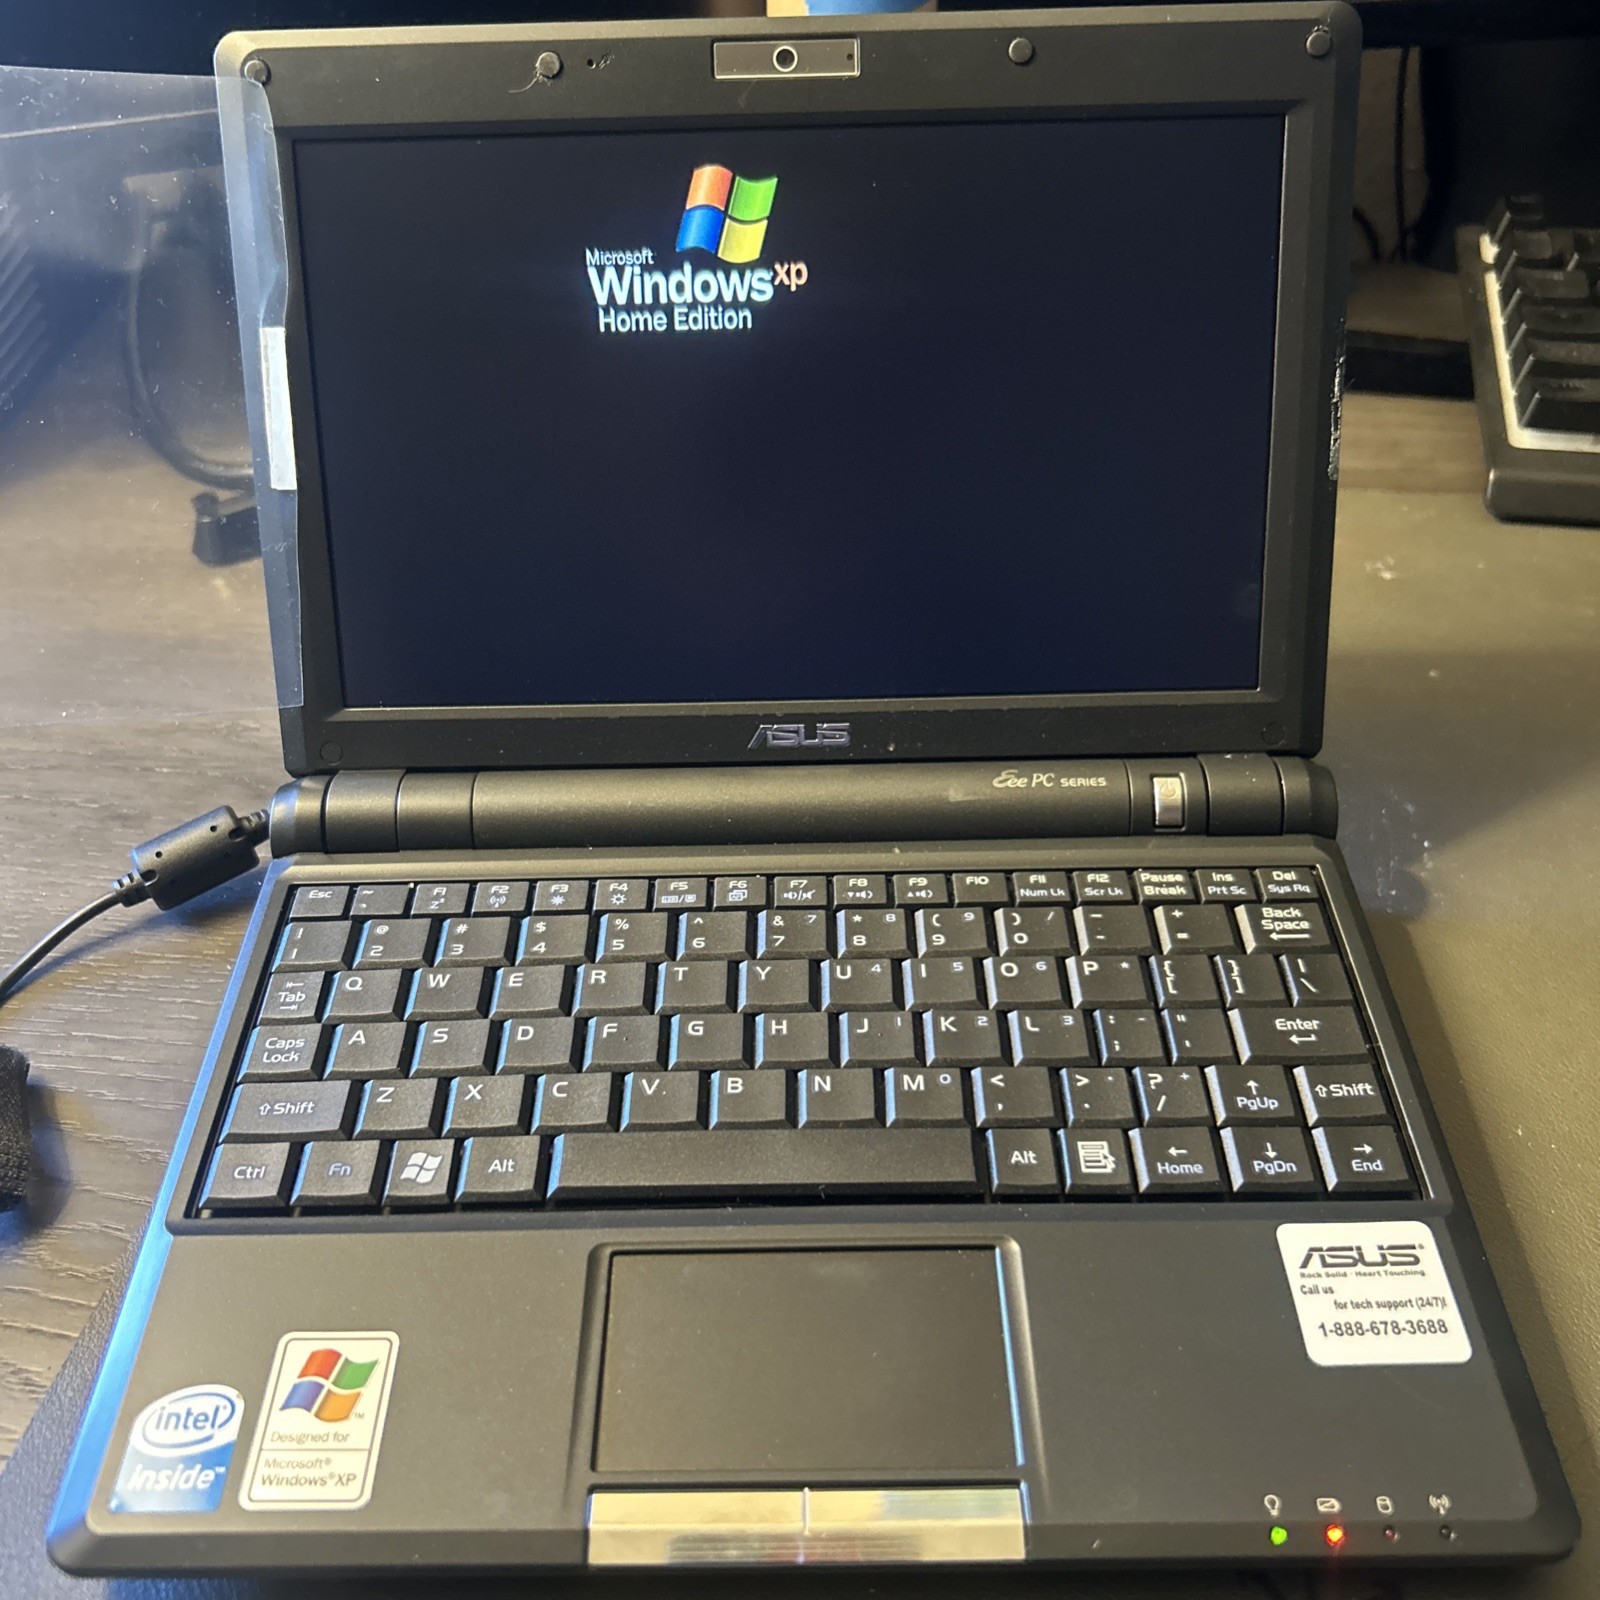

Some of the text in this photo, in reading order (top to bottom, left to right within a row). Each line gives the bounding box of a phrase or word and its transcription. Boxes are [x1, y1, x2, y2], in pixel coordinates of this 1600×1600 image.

[585, 247, 654, 266] Microsoft
[587, 261, 809, 306] Windows xp
[598, 304, 753, 333] Home Edition
[747, 722, 851, 750] ASUS
[992, 769, 1107, 788] Eee PC SERIES
[848, 878, 868, 887] F8
[908, 877, 928, 887] F9
[1140, 872, 1184, 883] Pause
[1211, 872, 1234, 882] Ins
[1272, 870, 1297, 881] Del
[490, 885, 510, 894] F2
[550, 883, 569, 893] F3
[609, 882, 629, 892] F4
[669, 881, 689, 891] F5
[728, 880, 748, 889] F6
[789, 879, 808, 889] F7
[1143, 885, 1187, 896] Break
[1207, 885, 1247, 895] Prt Sc
[1267, 883, 1311, 894] Sys Rq
[308, 889, 333, 899] Esc
[1019, 888, 1066, 897] Num Lk
[1084, 887, 1123, 896] Scr Lk
[807, 914, 817, 924] 7
[885, 913, 896, 922] 8
[963, 912, 975, 921] 9
[1011, 912, 1021, 926] )
[1047, 911, 1054, 921] /
[1261, 907, 1302, 918] Back
[535, 921, 547, 933] $
[614, 918, 630, 930] %
[772, 915, 785, 927] &
[932, 913, 941, 927] (
[1260, 919, 1310, 932] Space
[375, 925, 390, 935] @
[456, 923, 469, 934] #
[612, 939, 625, 951] 5
[692, 937, 706, 949] 6
[772, 935, 785, 947] 7
[852, 934, 867, 946] 8
[932, 933, 946, 946] 9
[369, 945, 384, 957] 2
[450, 943, 464, 955] 3
[532, 941, 547, 954] 4
[836, 965, 852, 980] U
[870, 963, 882, 973] 4
[952, 961, 964, 972] 5
[1000, 962, 1019, 977] O
[1035, 961, 1047, 971] 6
[1082, 960, 1099, 976] P
[1163, 960, 1175, 976] {
[1227, 959, 1239, 977] }
[428, 973, 451, 988] W
[508, 972, 524, 987] E
[590, 969, 607, 984] R
[673, 966, 689, 981] T
[755, 966, 772, 981] Y
[344, 976, 363, 991] Q
[1165, 977, 1178, 994] [
[1232, 976, 1244, 994] ]
[1300, 977, 1317, 993] \
[278, 991, 306, 1003] Tab
[771, 1019, 787, 1035] H
[856, 1018, 869, 1034] J
[940, 1016, 957, 1032] K
[977, 1015, 988, 1026] 2
[1024, 1016, 1040, 1032] L
[1062, 1015, 1074, 1026] 3
[1274, 1018, 1320, 1031] Enter
[516, 1025, 534, 1041] D
[602, 1022, 618, 1038] F
[687, 1020, 704, 1036] G
[347, 1029, 366, 1045] A
[432, 1027, 449, 1044] S
[265, 1037, 306, 1051] Caps
[262, 1050, 300, 1063] Lock
[641, 1078, 660, 1095] V
[727, 1077, 743, 1094] B
[814, 1075, 831, 1092] N
[903, 1074, 925, 1091] M
[990, 1074, 1005, 1087] <
[1075, 1074, 1090, 1087] >
[1147, 1073, 1163, 1090] ?
[376, 1086, 395, 1103] Z
[464, 1083, 484, 1101] X
[552, 1081, 569, 1098] C
[1329, 1082, 1375, 1097] Shift
[272, 1101, 315, 1115] Shift
[1156, 1095, 1167, 1112] /
[1236, 1096, 1279, 1111] PgUp
[1010, 1150, 1037, 1164] Alt
[234, 1165, 266, 1179] Ctrl
[328, 1162, 351, 1176] Fn
[487, 1158, 515, 1173] Alt
[1156, 1162, 1204, 1175] Home
[1252, 1160, 1297, 1175] PgDn
[1351, 1159, 1383, 1172] End
[1299, 1243, 1421, 1269] ASUS
[1300, 1269, 1426, 1279] Rock Solid Heart Touching
[1300, 1284, 1334, 1295] Call us
[1334, 1298, 1348, 1310] for
[1350, 1298, 1373, 1310] tech
[1375, 1298, 1414, 1312] support
[1318, 1318, 1449, 1338] 1-888-678-3688
[154, 1404, 220, 1432] intel
[270, 1430, 350, 1446] Designed for
